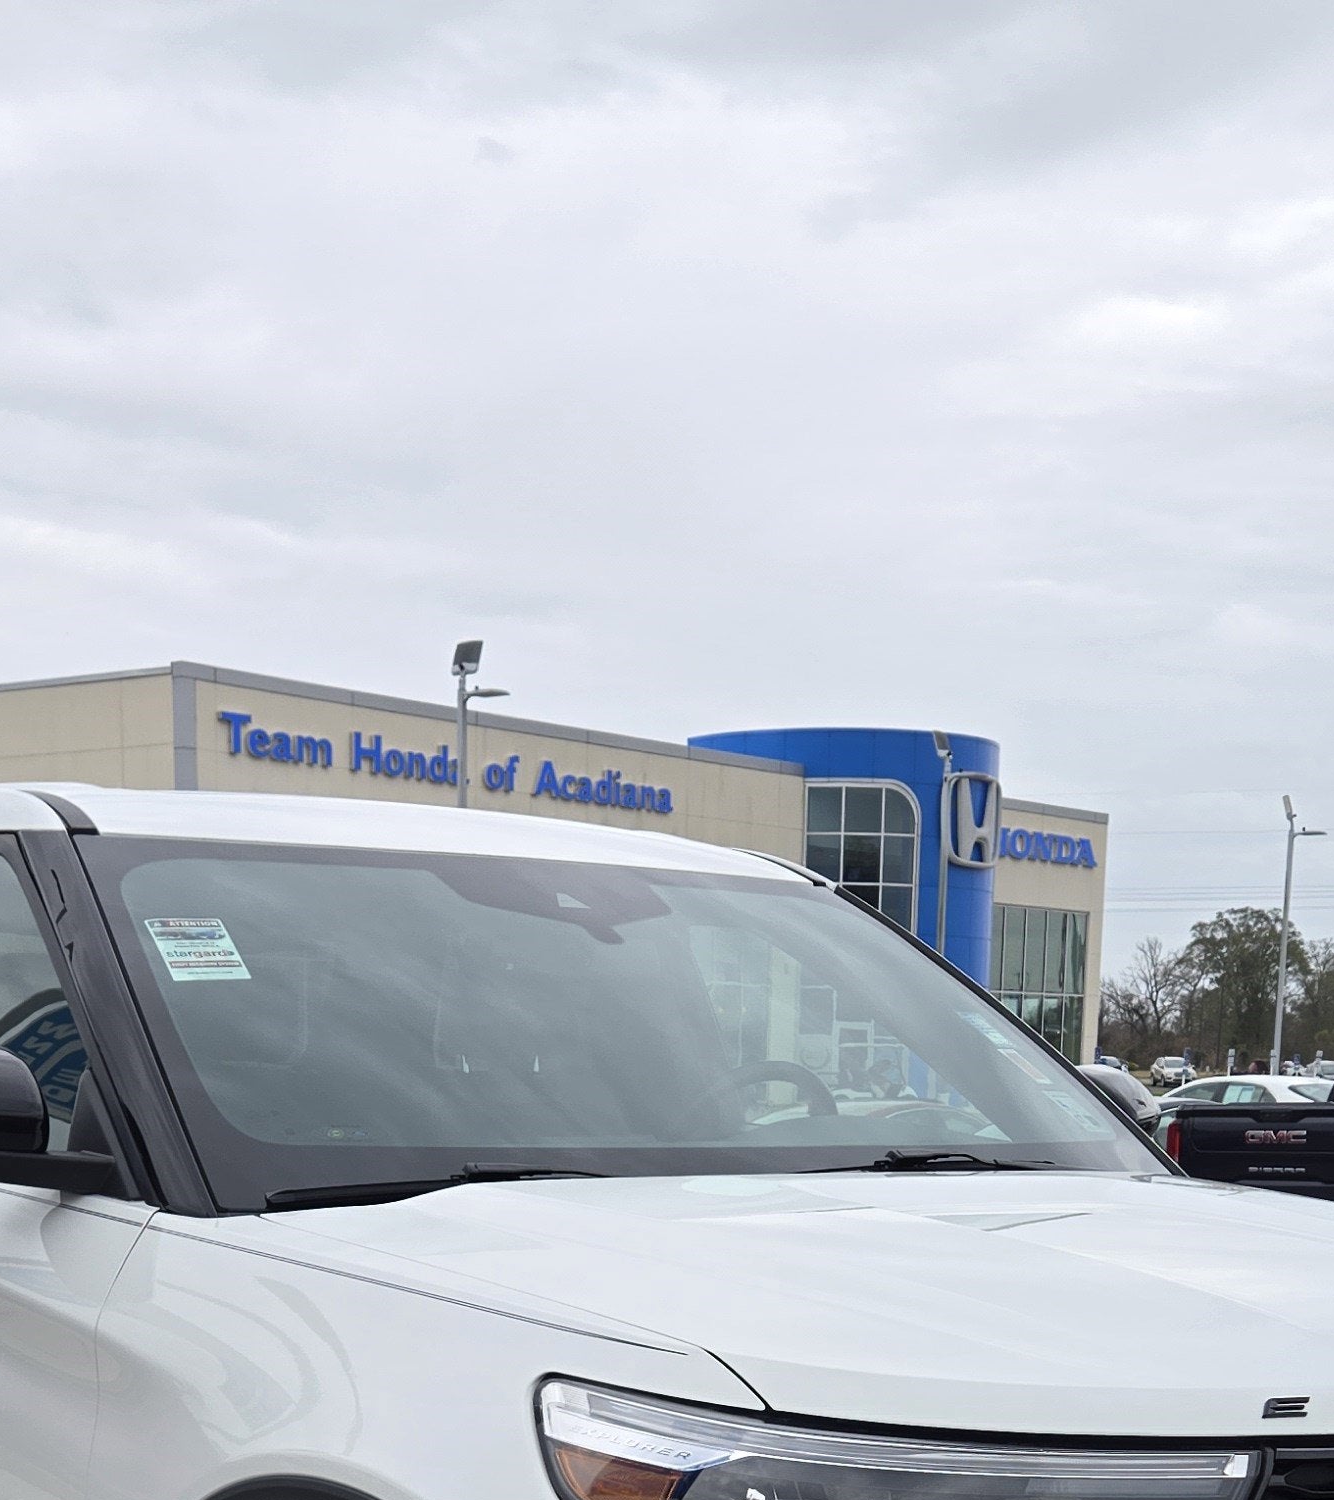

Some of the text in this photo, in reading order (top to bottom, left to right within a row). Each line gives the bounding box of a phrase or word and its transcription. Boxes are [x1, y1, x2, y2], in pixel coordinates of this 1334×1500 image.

[218, 711, 334, 768] Team
[483, 755, 520, 792] of
[531, 760, 673, 814] Acadiana
[1245, 1130, 1307, 1144] GMC
